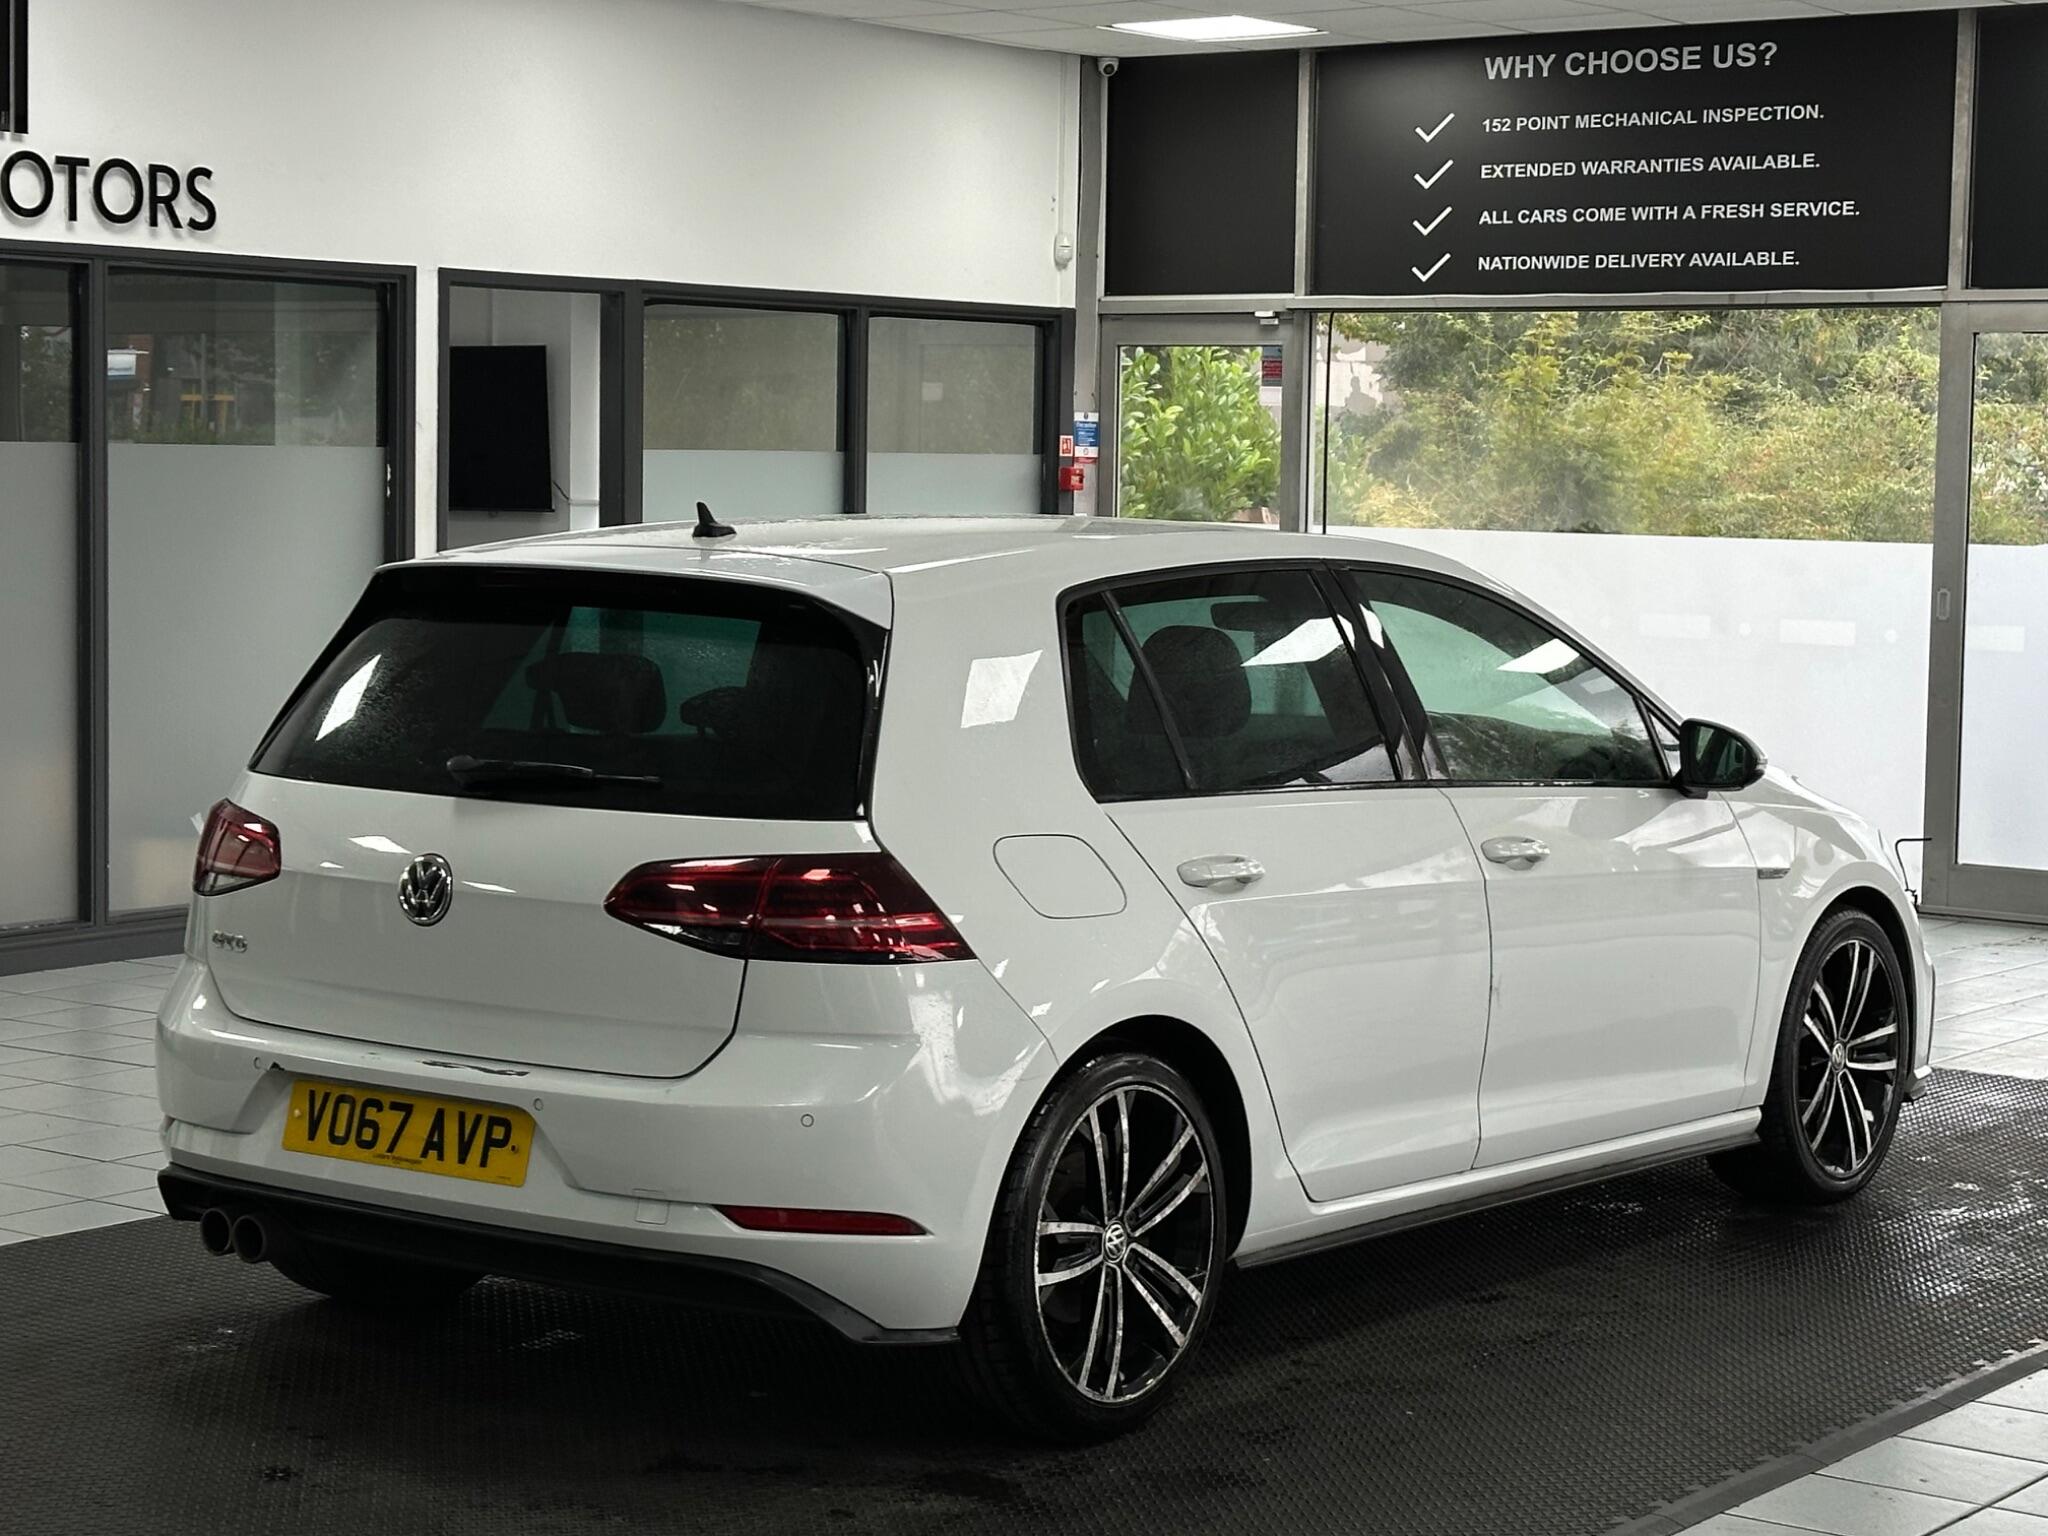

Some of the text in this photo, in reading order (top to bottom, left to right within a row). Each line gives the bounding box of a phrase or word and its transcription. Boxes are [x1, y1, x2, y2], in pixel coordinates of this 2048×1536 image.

[1485, 42, 1777, 80] WHY CHOOSE US?
[1482, 105, 1824, 132] 152 POINT MECHANICAL INSPECTION.
[1480, 153, 1820, 178] EXTENDED WARRANTIES AVAILABLE.
[1, 150, 217, 232] OTORS
[1479, 201, 1860, 224] ALL CARS COME WITH A FRESH SERVICE.
[1478, 251, 1800, 270] NATIONWIDE DELIVERY AVAILABLE.
[307, 1089, 512, 1168] VO67 AVP
